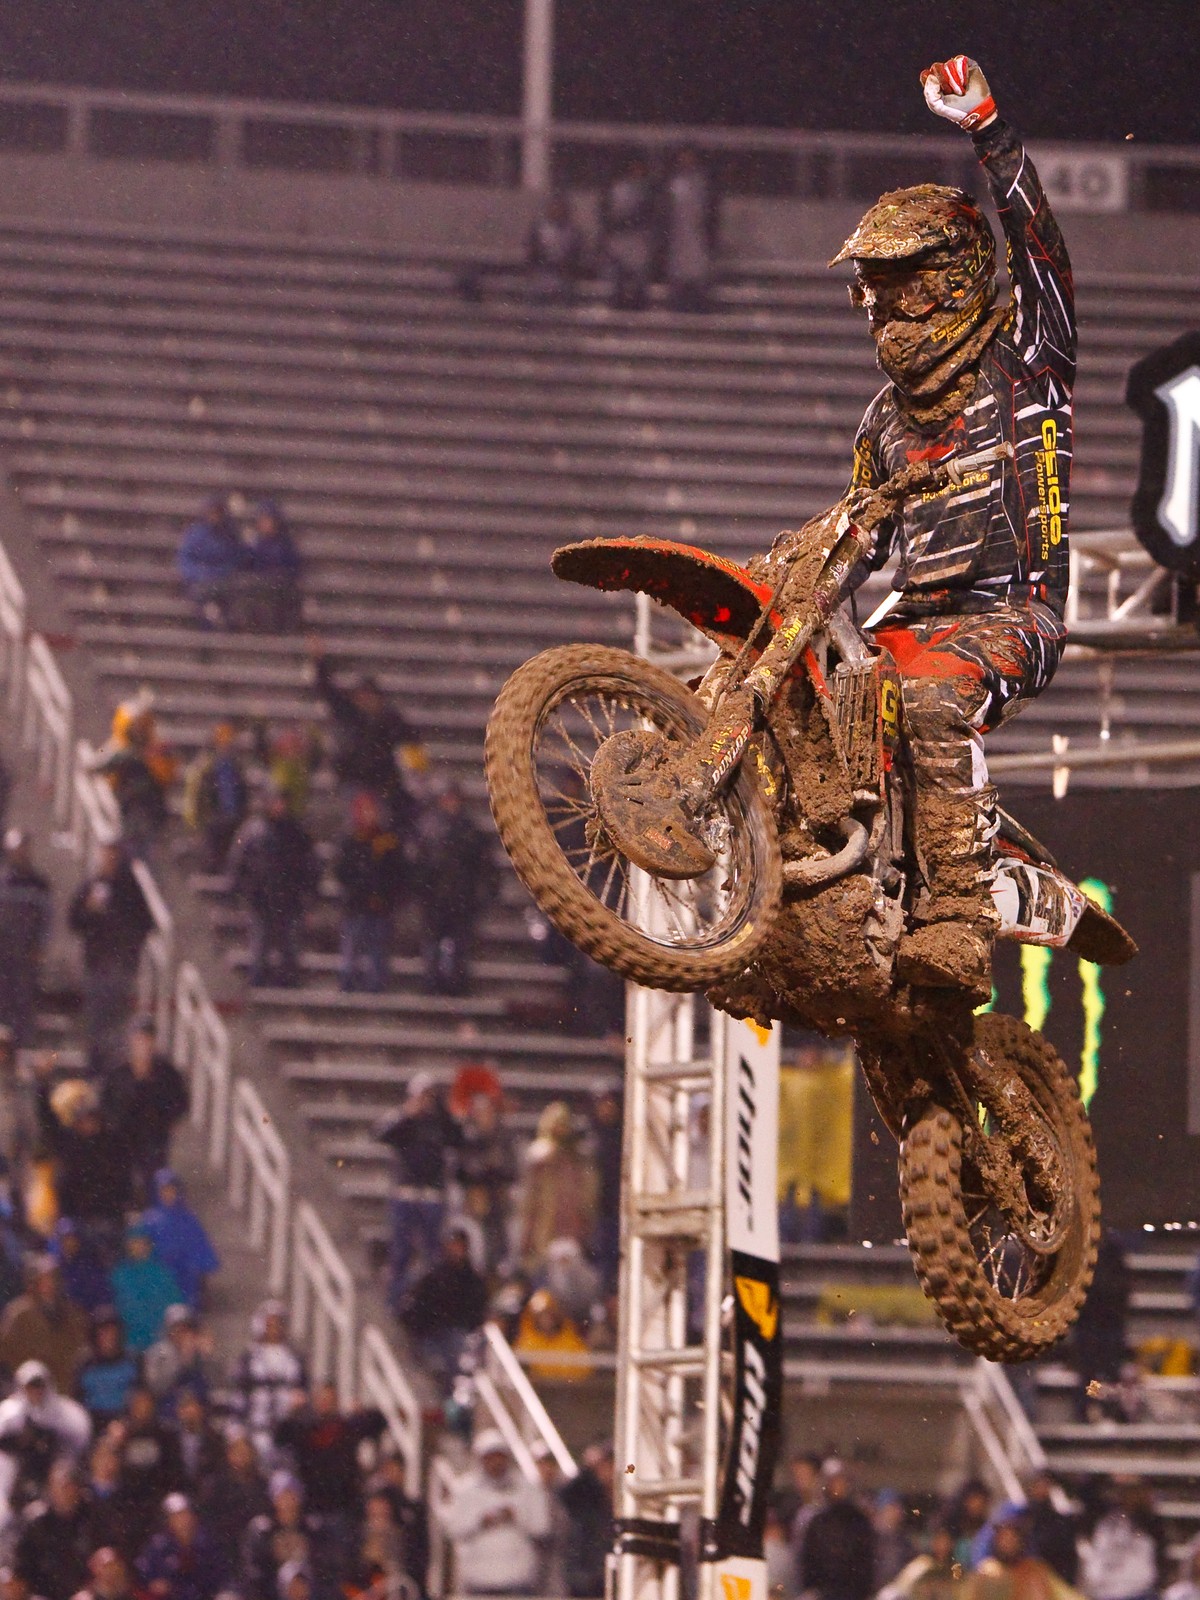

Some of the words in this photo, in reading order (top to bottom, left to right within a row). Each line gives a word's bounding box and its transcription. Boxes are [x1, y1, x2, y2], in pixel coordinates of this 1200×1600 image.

[931, 290, 985, 343] GEICO
[1041, 418, 1062, 546] GEICO
[712, 725, 749, 786] DUNLOP
